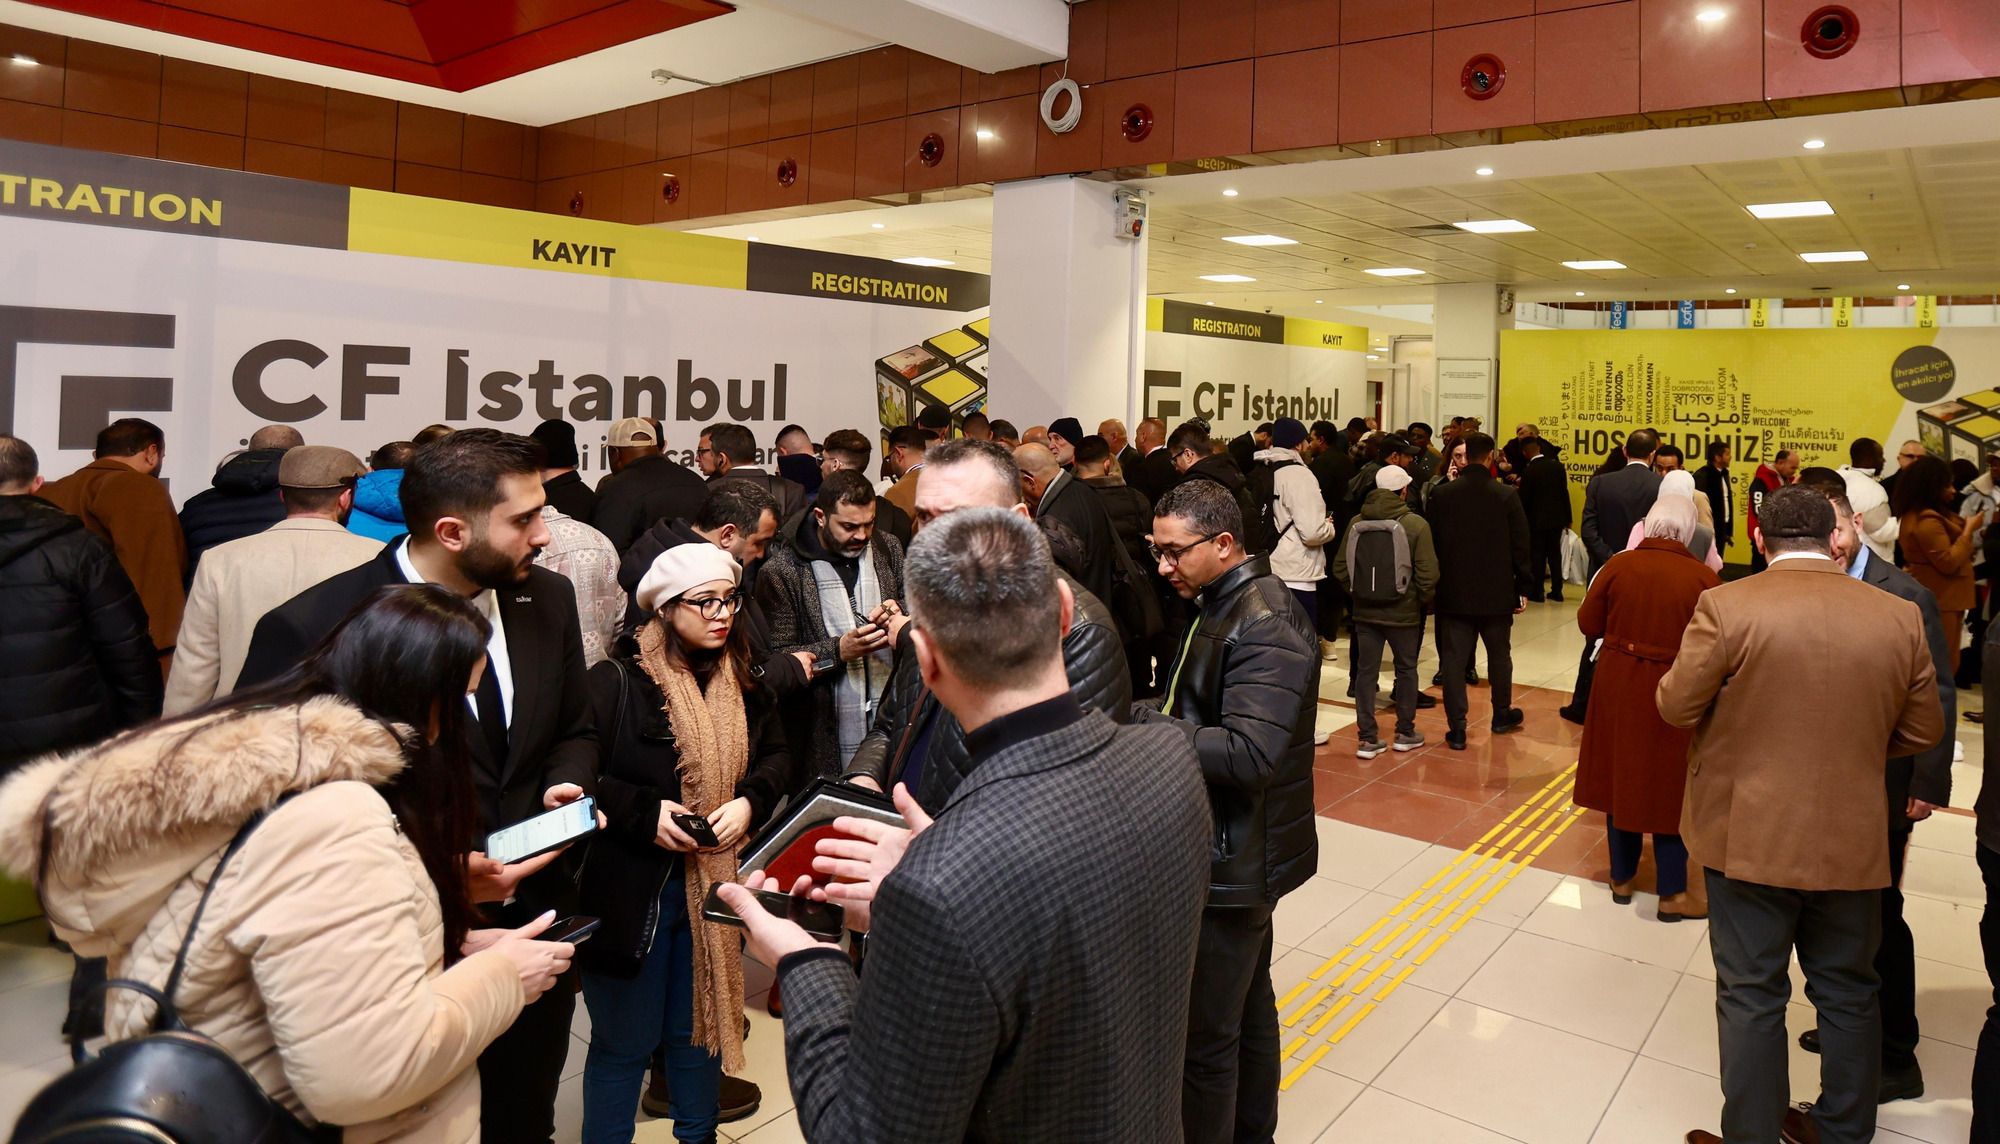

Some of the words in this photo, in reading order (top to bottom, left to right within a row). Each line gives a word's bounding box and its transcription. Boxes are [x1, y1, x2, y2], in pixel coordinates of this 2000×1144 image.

[532, 239, 616, 268] KAYIT
[811, 271, 948, 304] REGISTRATION
[1193, 318, 1261, 338] REGISTRATION
[1322, 334, 1343, 346] KAYIT
[232, 339, 411, 422] CF
[1605, 360, 1613, 411] BIENVENUE
[1646, 362, 1654, 424] WILLKOMMEN
[1717, 367, 1727, 410] WELKOM
[1193, 381, 1235, 420] CF
[1752, 417, 1791, 427] WELCOME
[1780, 441, 1839, 452] BIENVENUE
[1740, 472, 1749, 516] WELKOM
